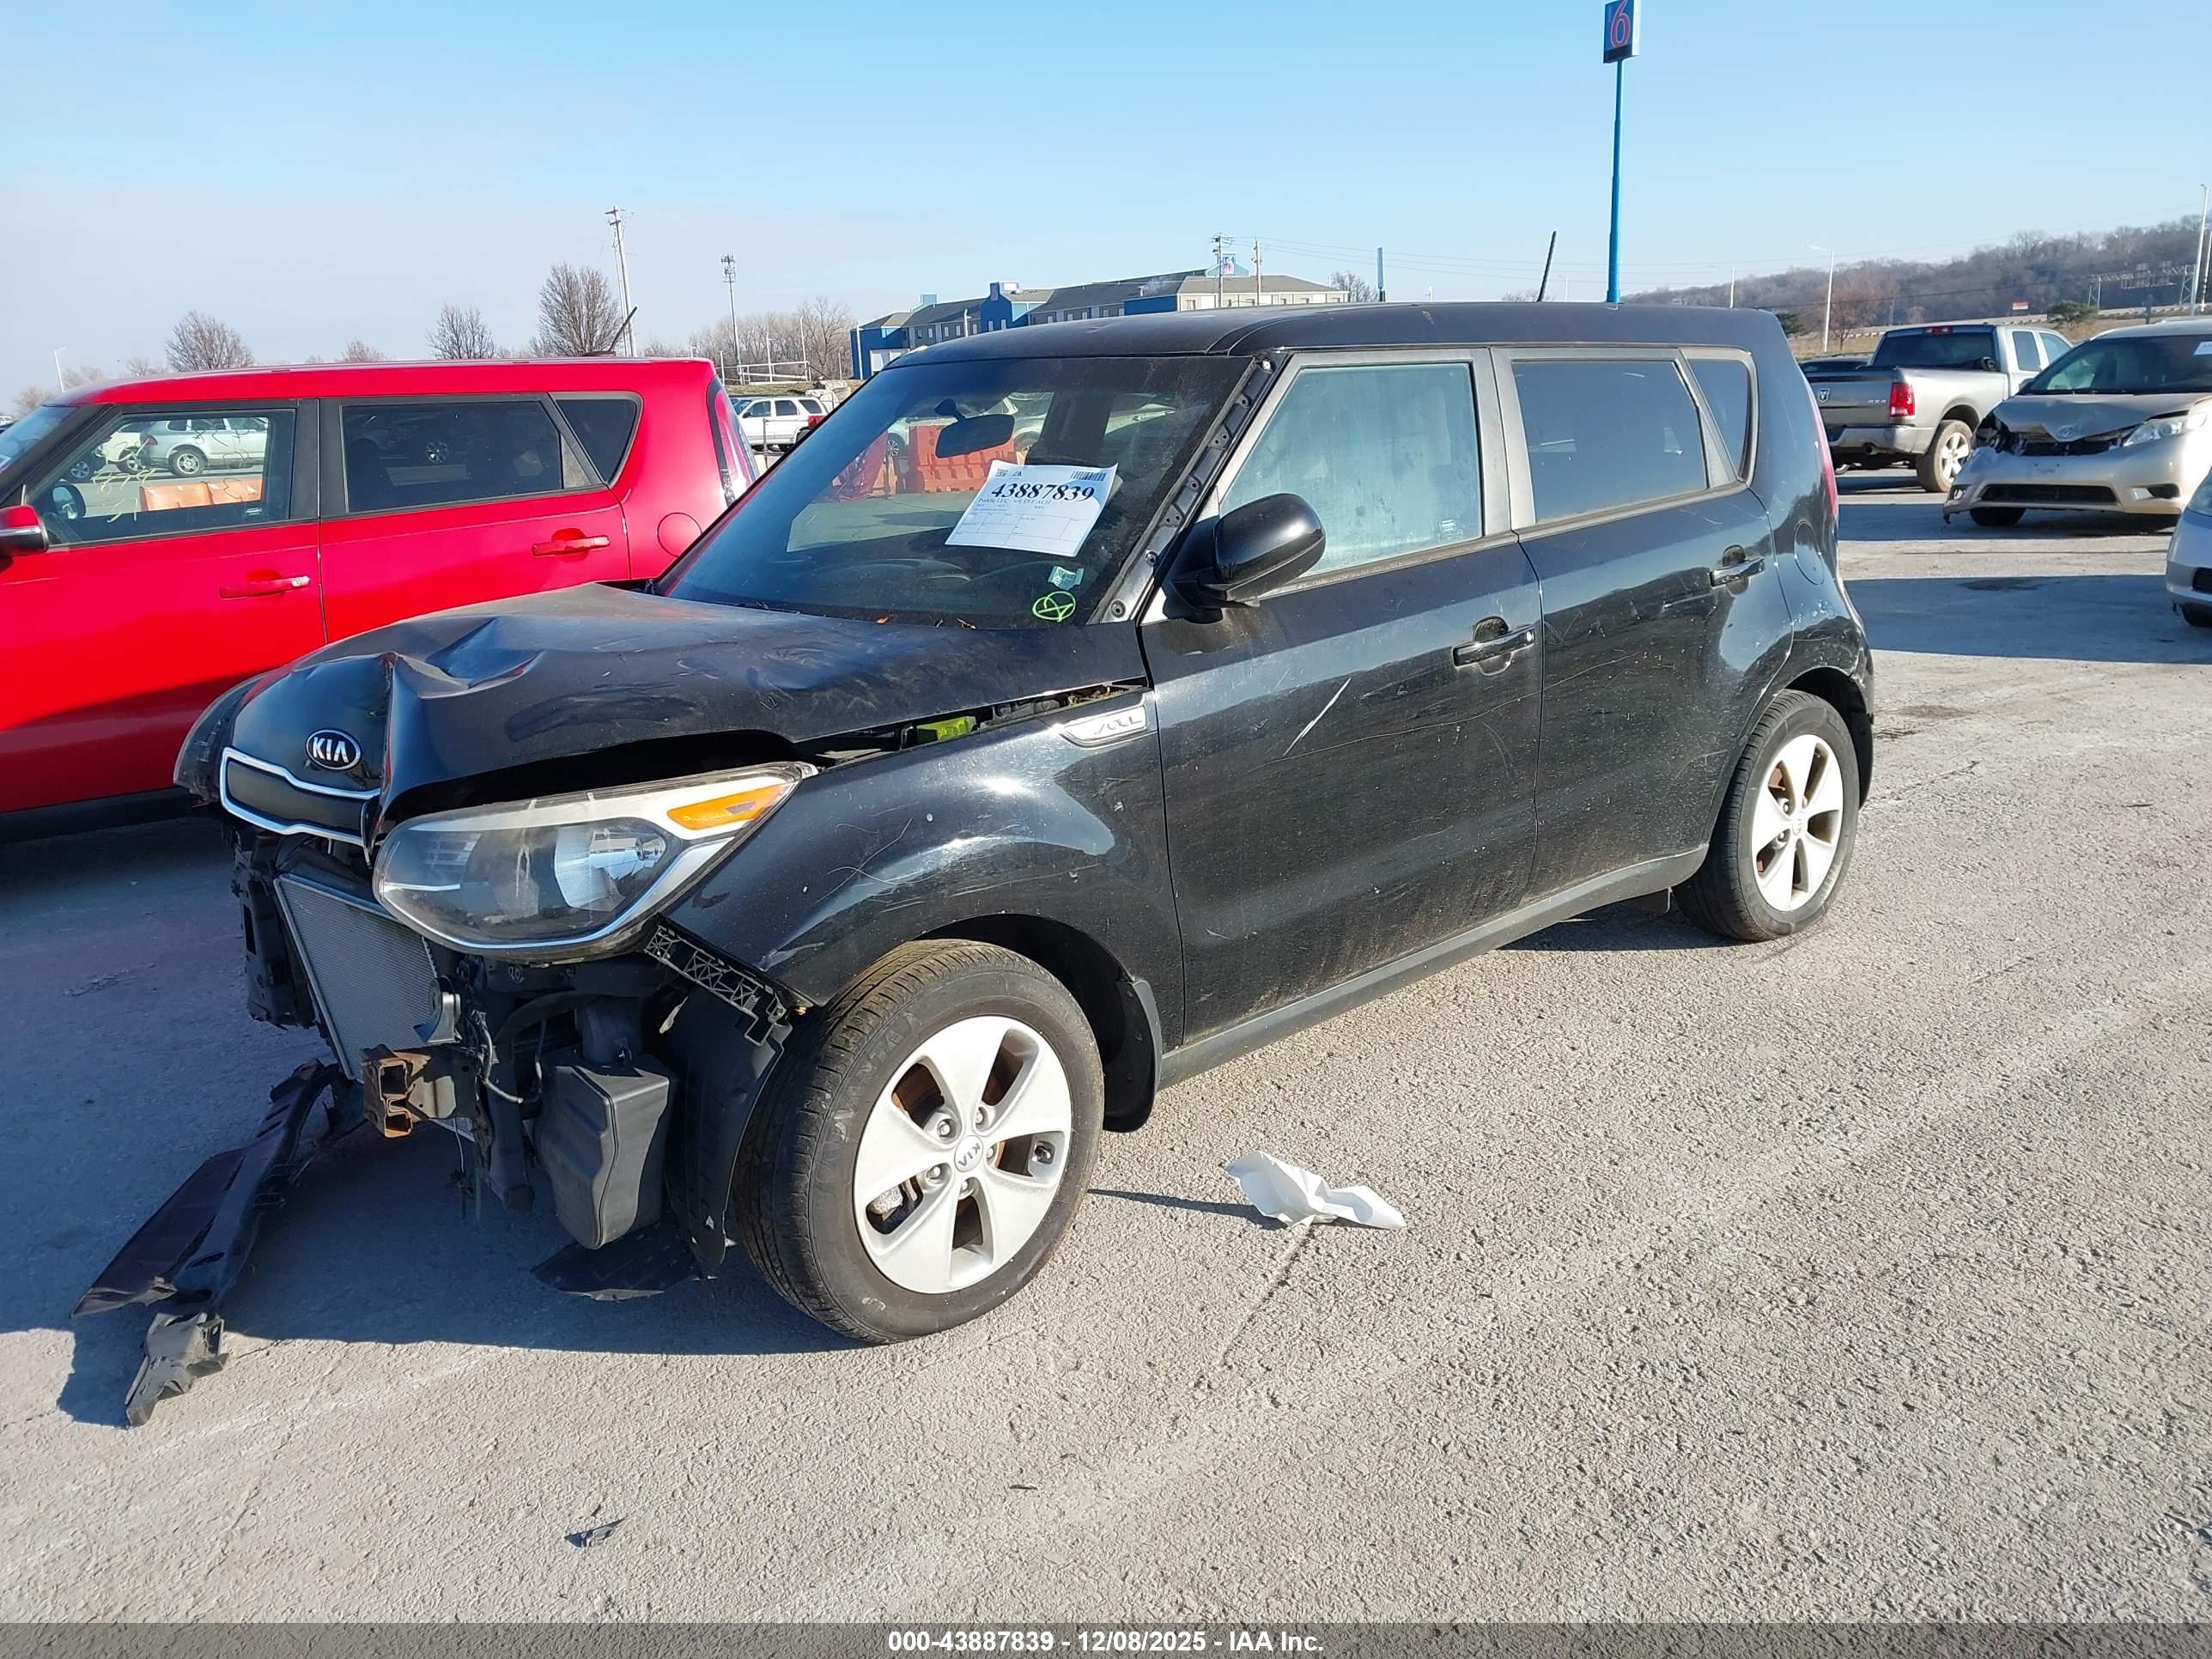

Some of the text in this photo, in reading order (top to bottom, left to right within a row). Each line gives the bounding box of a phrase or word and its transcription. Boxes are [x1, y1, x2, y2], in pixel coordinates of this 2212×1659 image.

[1610, 0, 1631, 47] 6
[991, 483, 1095, 501] 43887839
[313, 736, 349, 763] KIA
[957, 1143, 981, 1167] KIA
